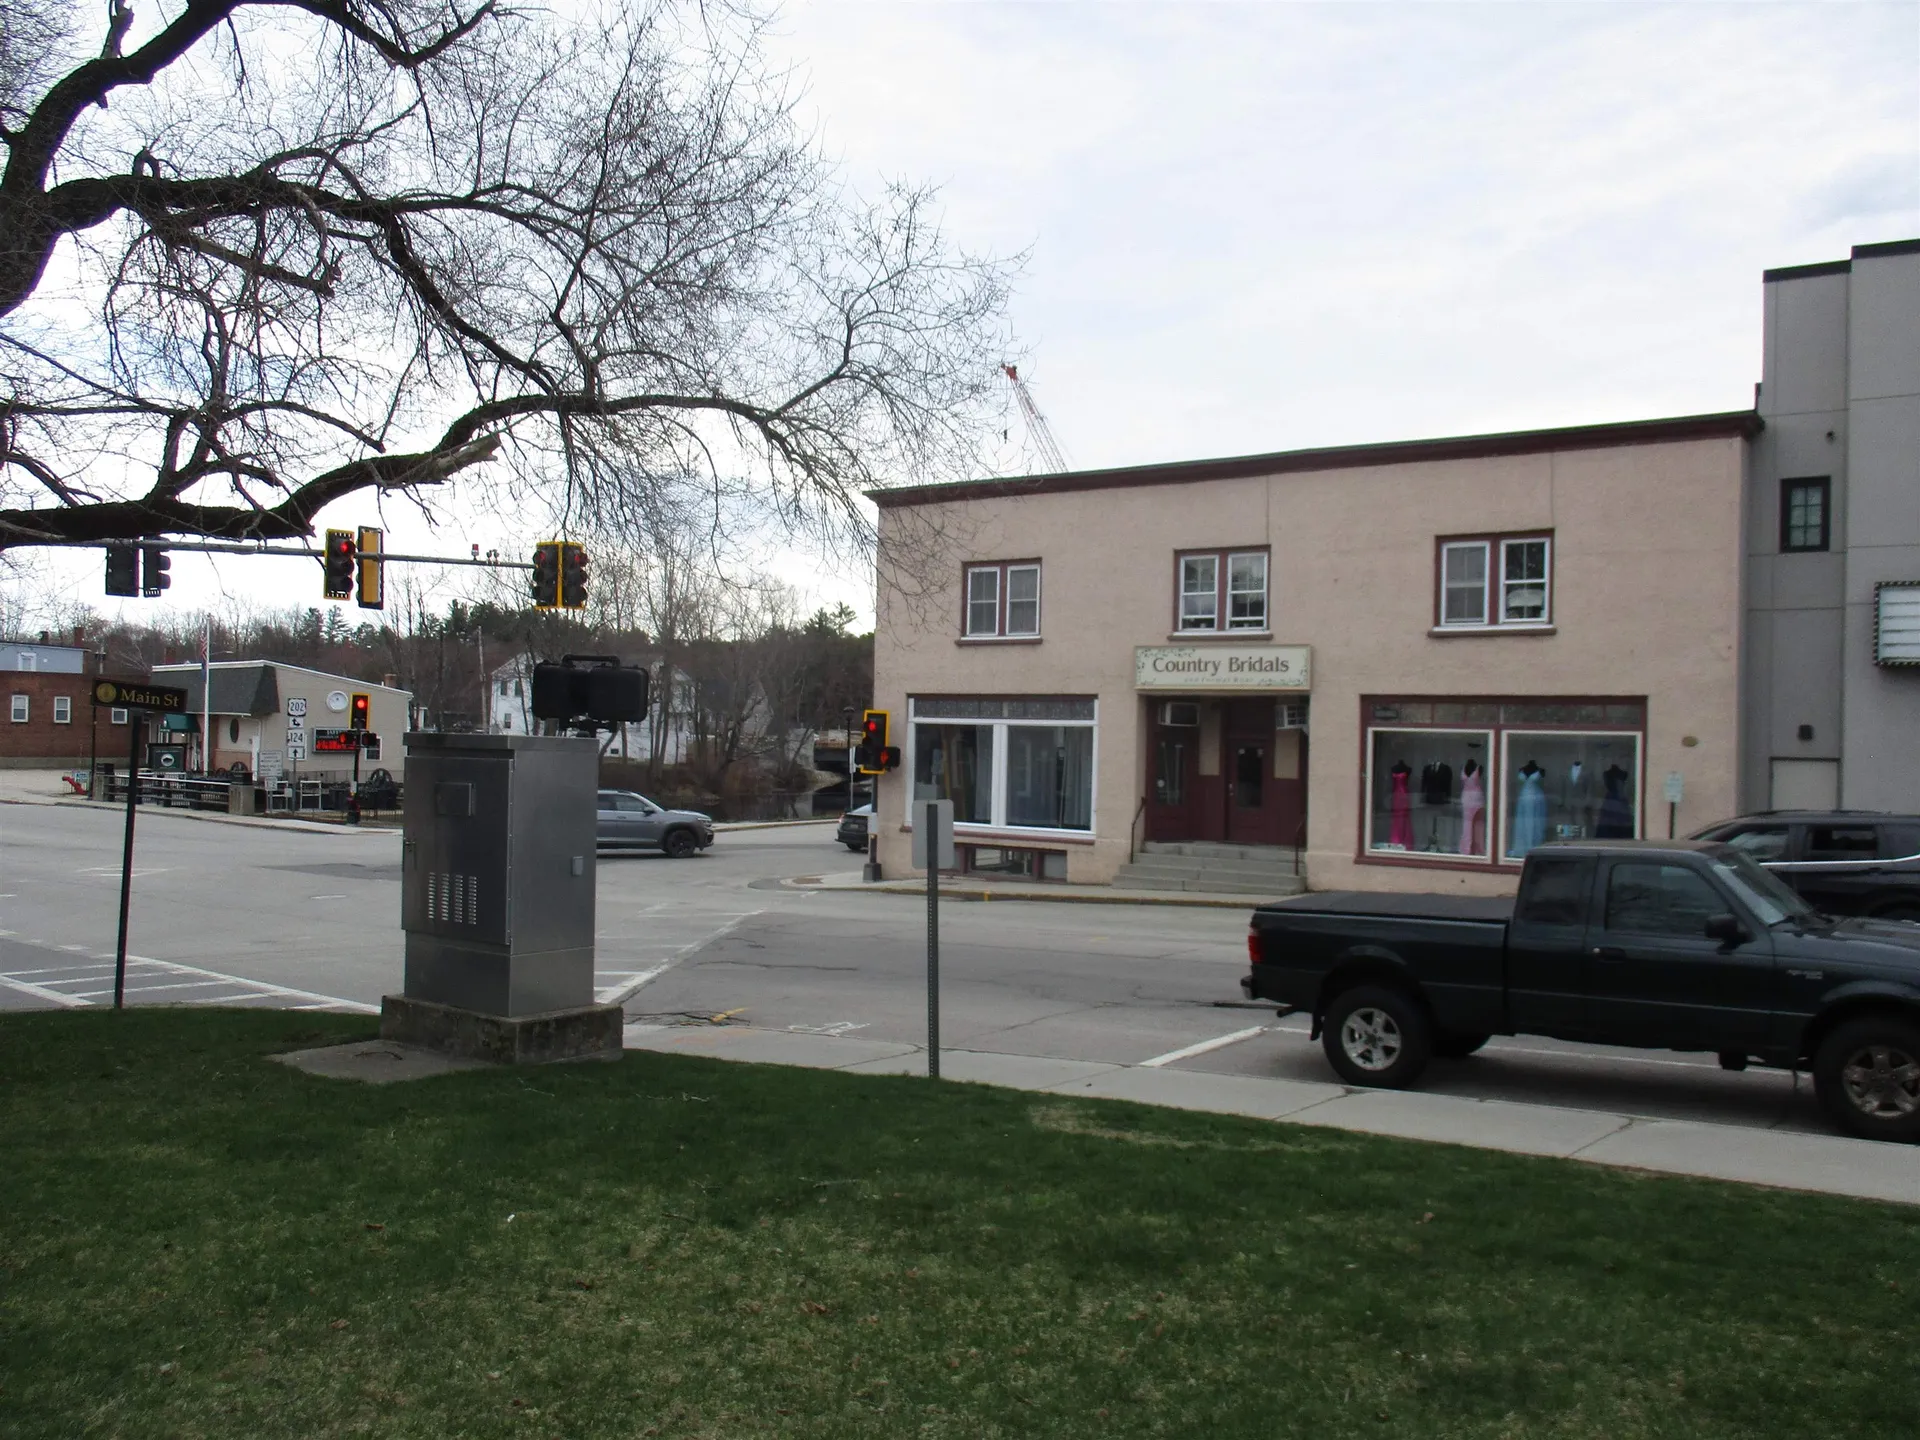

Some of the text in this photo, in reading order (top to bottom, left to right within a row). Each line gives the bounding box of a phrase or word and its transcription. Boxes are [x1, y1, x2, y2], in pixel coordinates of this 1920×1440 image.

[1153, 656, 1290, 677] Country Bridals
[121, 689, 180, 707] Main St
[290, 702, 304, 712] 202
[290, 732, 303, 743] 124
